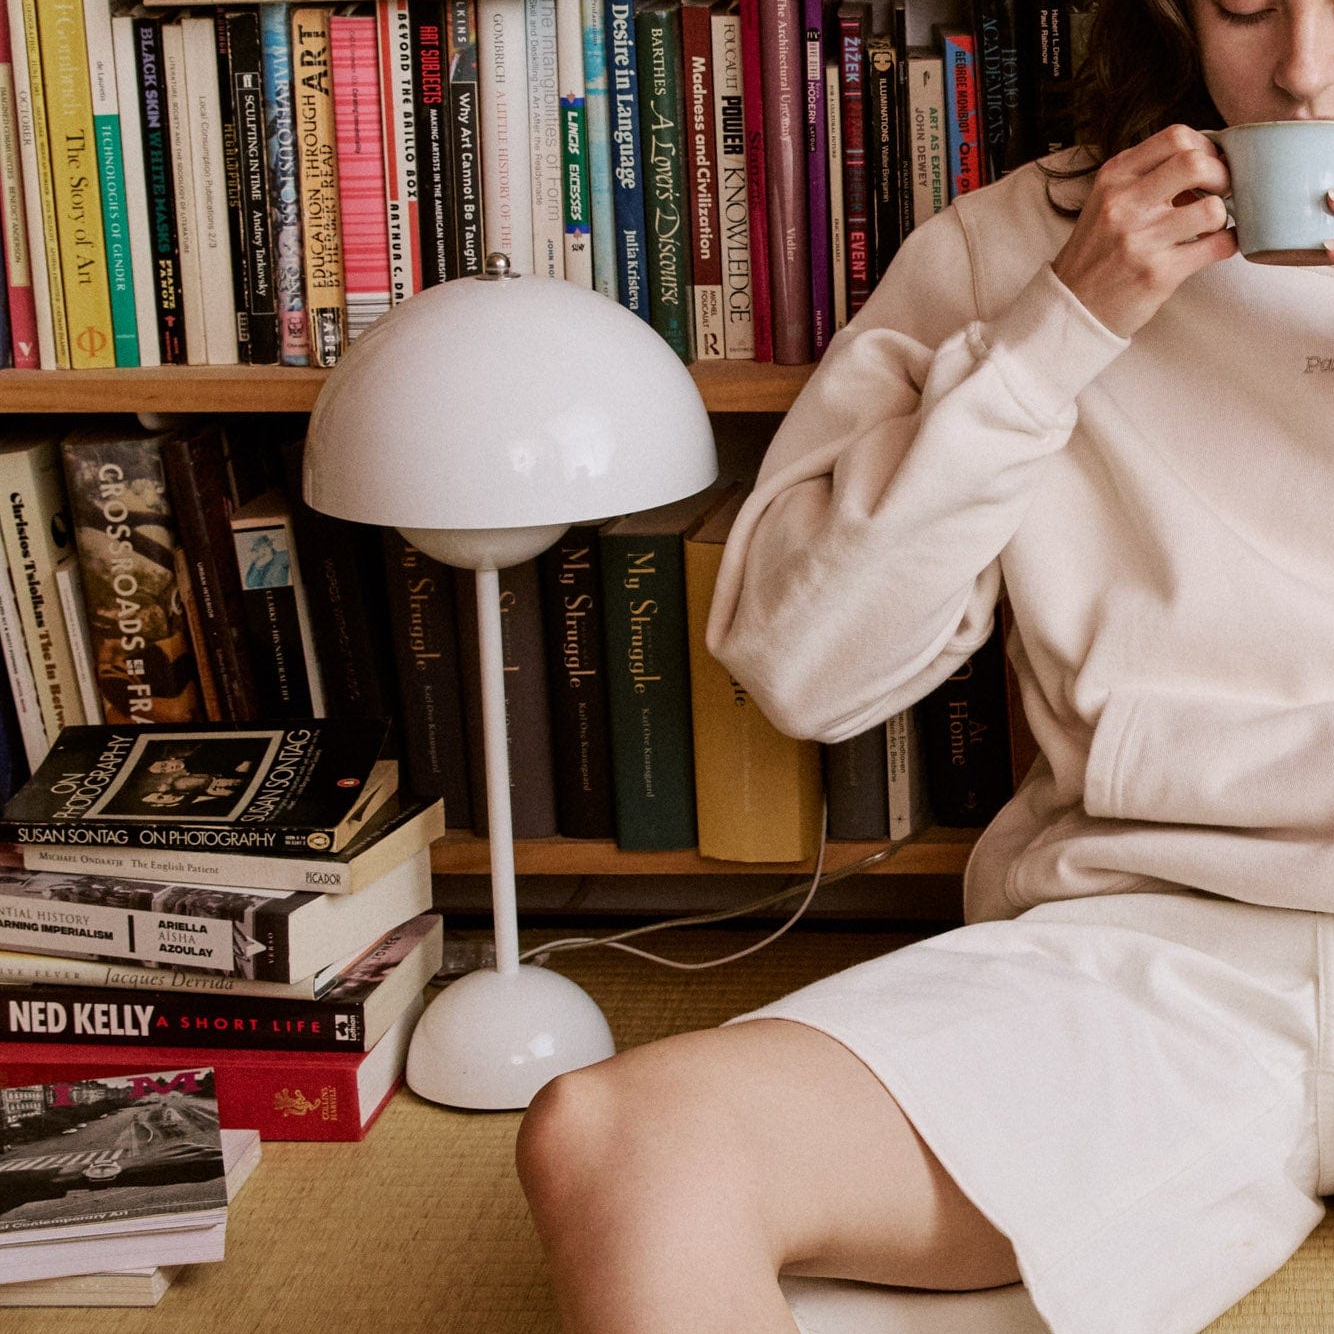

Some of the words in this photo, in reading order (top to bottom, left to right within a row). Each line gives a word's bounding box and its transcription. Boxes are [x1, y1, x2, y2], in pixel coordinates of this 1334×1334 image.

[611, 4, 635, 66] Desire
[139, 27, 157, 87] BLACK
[650, 28, 666, 96] BARTHES
[614, 69, 632, 90] in
[691, 56, 707, 131] Madness
[144, 90, 161, 129] SKIN
[244, 95, 259, 157] SCULPTING
[458, 93, 470, 123] Why
[649, 100, 670, 131] A
[914, 107, 926, 141] JOHN
[65, 129, 87, 170] The
[460, 127, 474, 148] Art
[615, 94, 637, 189] Language
[694, 134, 708, 165] and
[100, 125, 122, 218] TECHNOLOGIES
[148, 131, 166, 195] WHITE
[250, 159, 259, 173] IN
[462, 152, 475, 200] Cannot
[650, 135, 676, 200] Lover's
[917, 145, 928, 187] DEWEY
[65, 176, 89, 224] Story
[251, 175, 261, 200] TIME
[111, 224, 123, 239] OF
[154, 198, 171, 254] MASKS
[252, 210, 265, 247] Andrey
[465, 204, 476, 220] Be
[695, 168, 713, 260] Civilization
[73, 229, 91, 247] of
[463, 224, 478, 271] Taught
[655, 203, 681, 306] Discourse
[850, 231, 866, 281] EVENT
[77, 254, 95, 286] Art
[111, 243, 127, 292] GENDER
[254, 247, 268, 296] Tarkovsky
[98, 463, 146, 651] CROSSROADS
[558, 547, 590, 584] My
[624, 552, 655, 590] My
[564, 595, 597, 689] Struggle
[627, 598, 662, 694] Struggle
[17, 828, 66, 843] SUSAN
[69, 829, 128, 844] SONTAG
[139, 830, 166, 845] ON
[169, 831, 276, 847] PHOTOGRAPHY
[41, 924, 114, 941] IMPERIALISM
[158, 920, 207, 934] ARIELLA
[159, 944, 213, 957] AZOULAY
[9, 1001, 68, 1034] NED
[74, 1004, 155, 1036] KELLY
[156, 1016, 169, 1028] A
[181, 1017, 258, 1029] SHORT
[272, 1020, 320, 1033] LIFE
